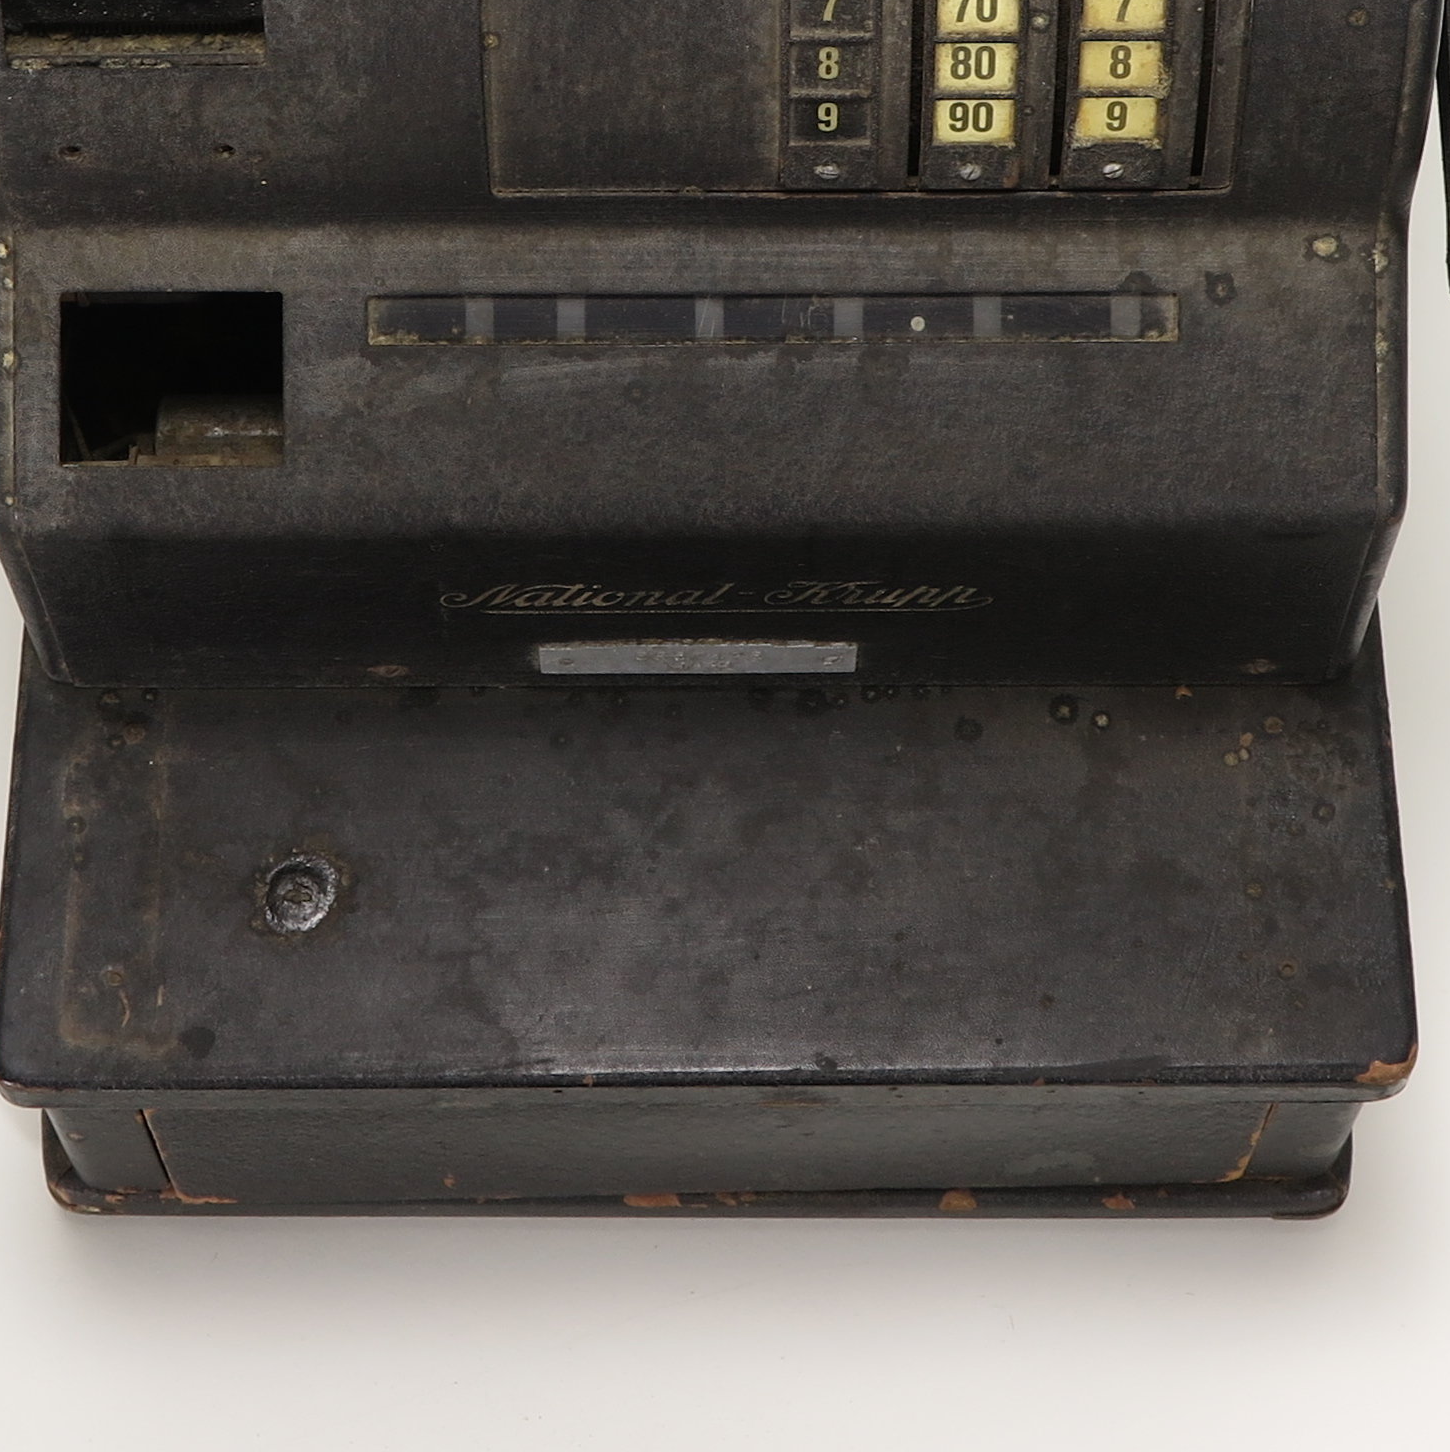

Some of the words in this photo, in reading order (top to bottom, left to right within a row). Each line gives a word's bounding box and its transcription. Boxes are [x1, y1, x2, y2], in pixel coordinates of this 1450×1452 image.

[818, 47, 840, 80] 8
[950, 46, 997, 80] 80
[1109, 46, 1132, 79] 8
[817, 101, 839, 132] 9
[948, 101, 994, 133] 90
[1105, 101, 1128, 132] 9
